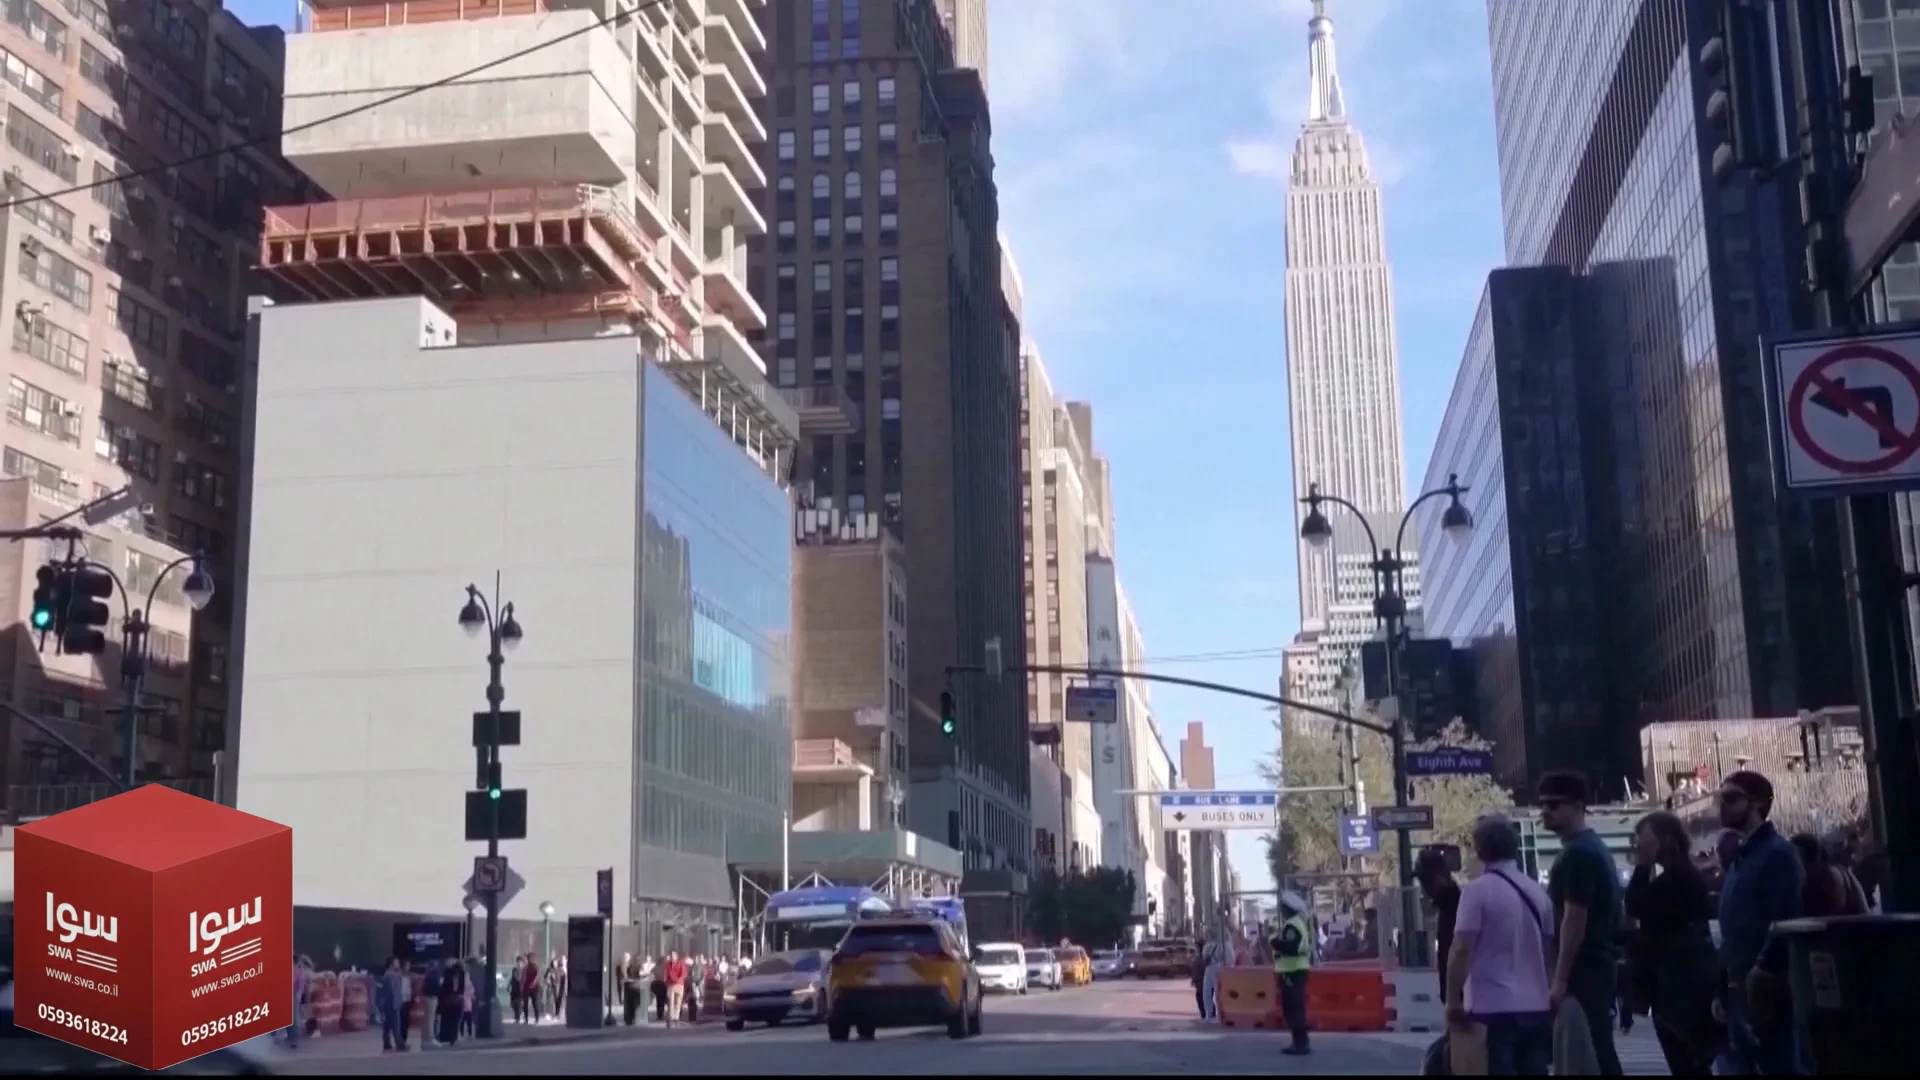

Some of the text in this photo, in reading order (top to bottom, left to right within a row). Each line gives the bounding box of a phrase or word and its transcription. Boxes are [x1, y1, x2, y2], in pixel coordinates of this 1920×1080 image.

[1417, 756, 1482, 770] Eighth Ave
[1201, 812, 1265, 822] BUSES ONLY
